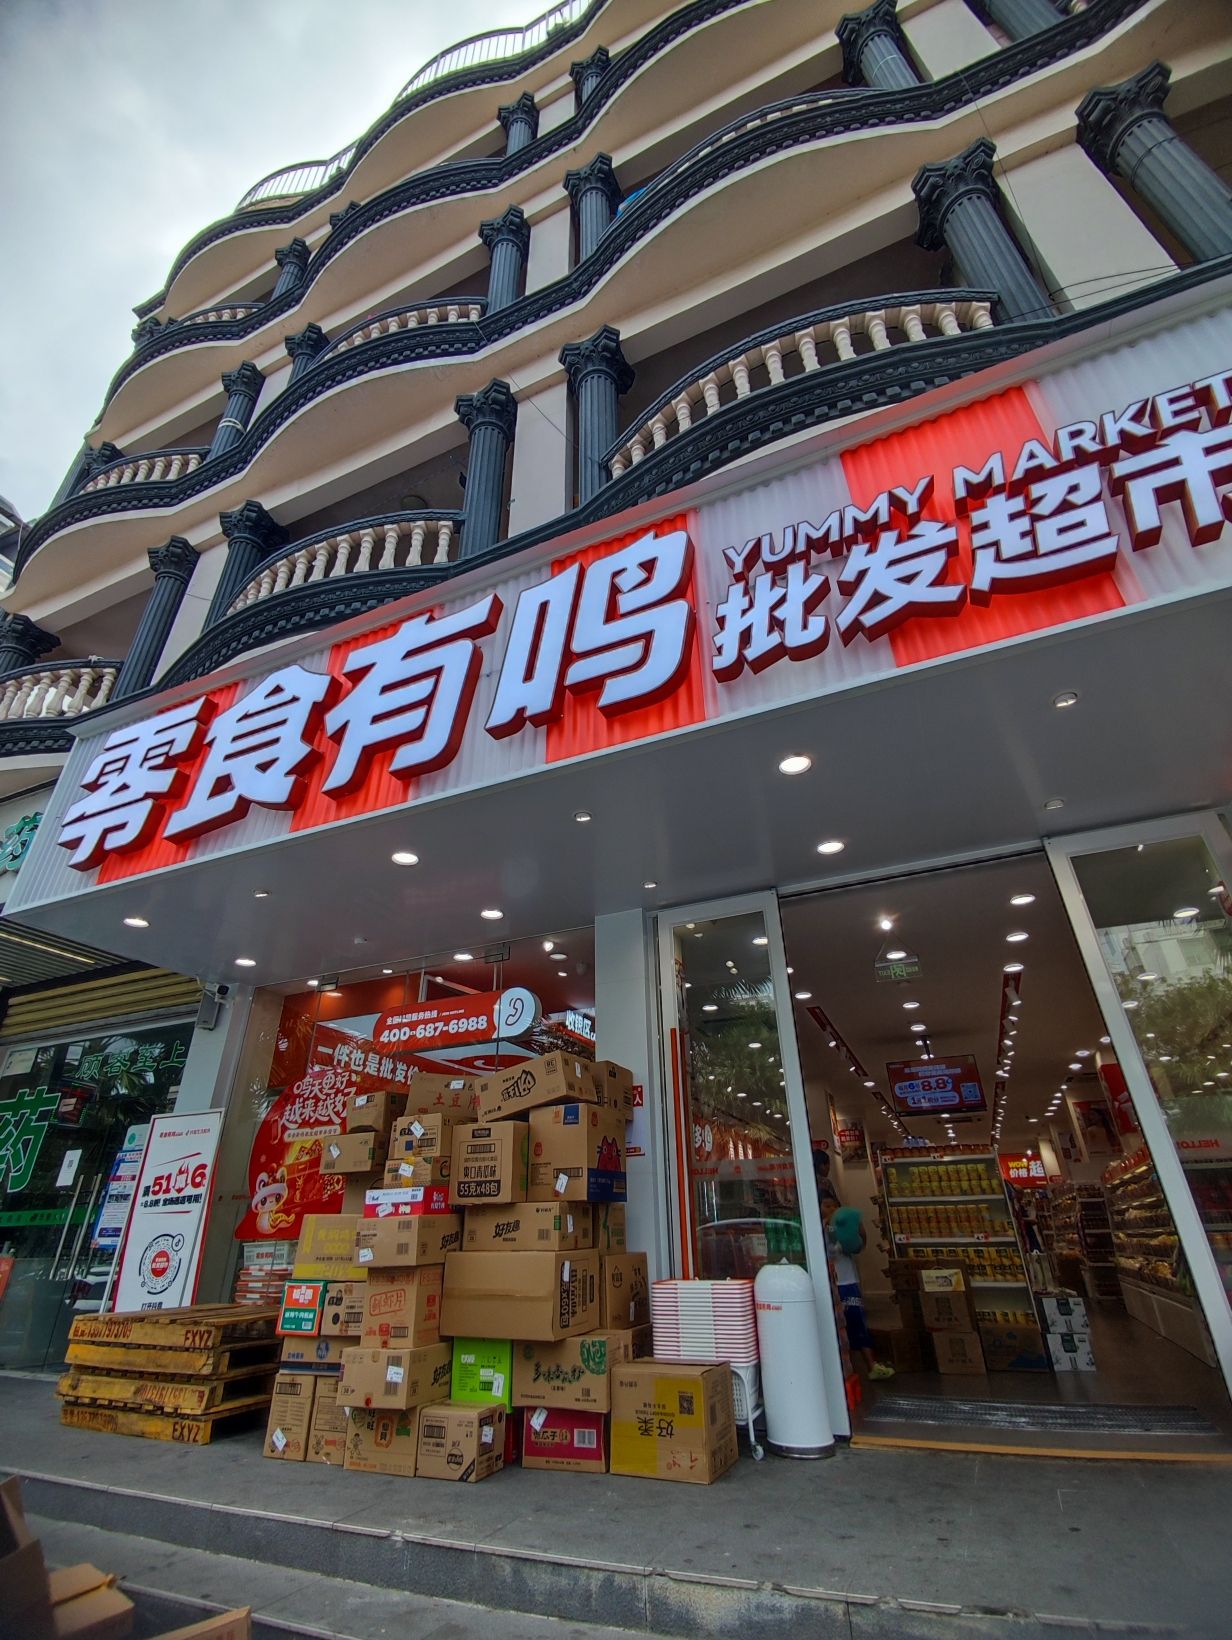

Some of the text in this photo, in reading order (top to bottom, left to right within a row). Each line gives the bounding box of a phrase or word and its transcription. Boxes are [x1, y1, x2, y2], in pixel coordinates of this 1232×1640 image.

[722, 368, 1232, 576] YUMMY MARKET
[712, 429, 1232, 674] 批发超市
[57, 530, 695, 870] 零食有鸣
[379, 1016, 488, 1043] 400-687-6988
[75, 1040, 187, 1080] 顾客至上
[0, 1086, 61, 1193] 药
[464, 1164, 496, 1179] 爽口青瓜味
[460, 1183, 498, 1195] 55克x48包
[493, 1219, 521, 1238] 好友趣
[637, 1416, 675, 1438] 好柔
